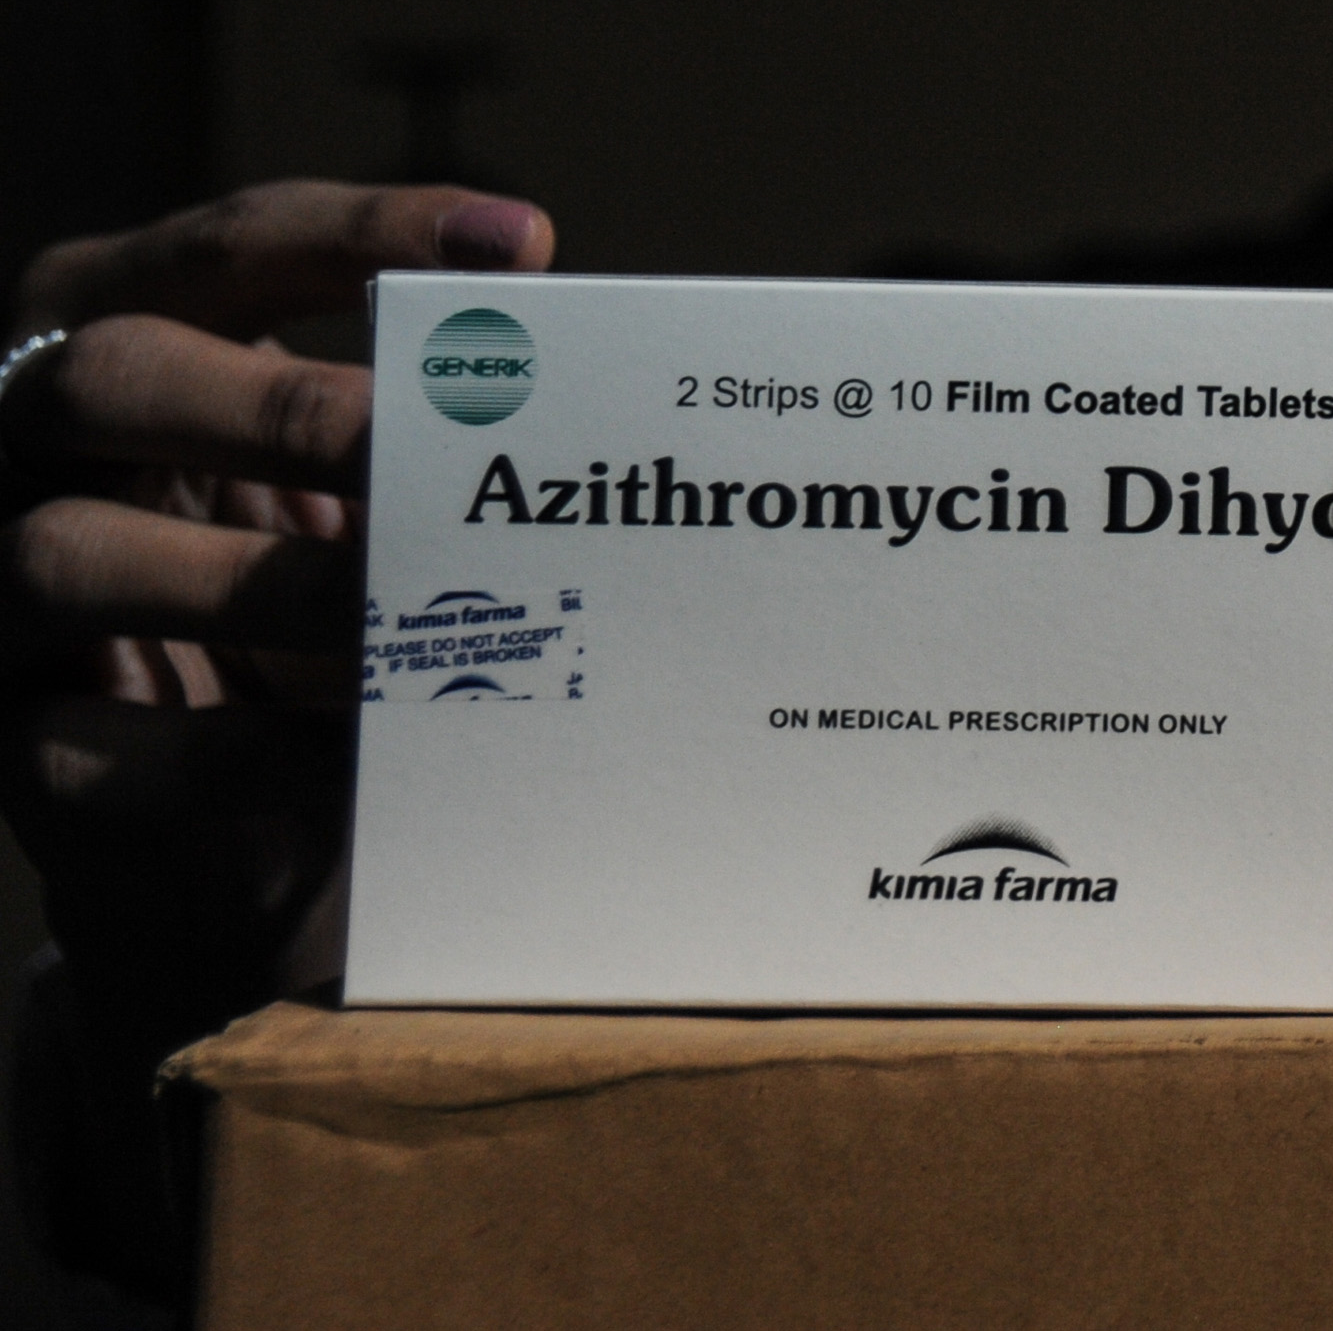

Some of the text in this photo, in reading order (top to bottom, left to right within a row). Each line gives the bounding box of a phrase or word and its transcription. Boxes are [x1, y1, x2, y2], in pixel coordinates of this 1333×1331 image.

[422, 356, 533, 378] GENERIK
[675, 375, 699, 408] 2
[712, 375, 820, 417] Strips
[833, 377, 874, 419] @
[890, 379, 933, 412] 10
[946, 380, 1030, 414] Film
[1044, 381, 1184, 417] Coated
[463, 453, 1069, 548] Azithromycin
[398, 605, 526, 630] kimia farma
[364, 626, 564, 659] PLEASE DO NOT ACCEPT
[389, 645, 542, 673] IF SEAL IS BROKEN
[768, 707, 1228, 735] ON MEDICAL PRESCRIPTION ONLY
[868, 866, 1118, 903] kimia farma
